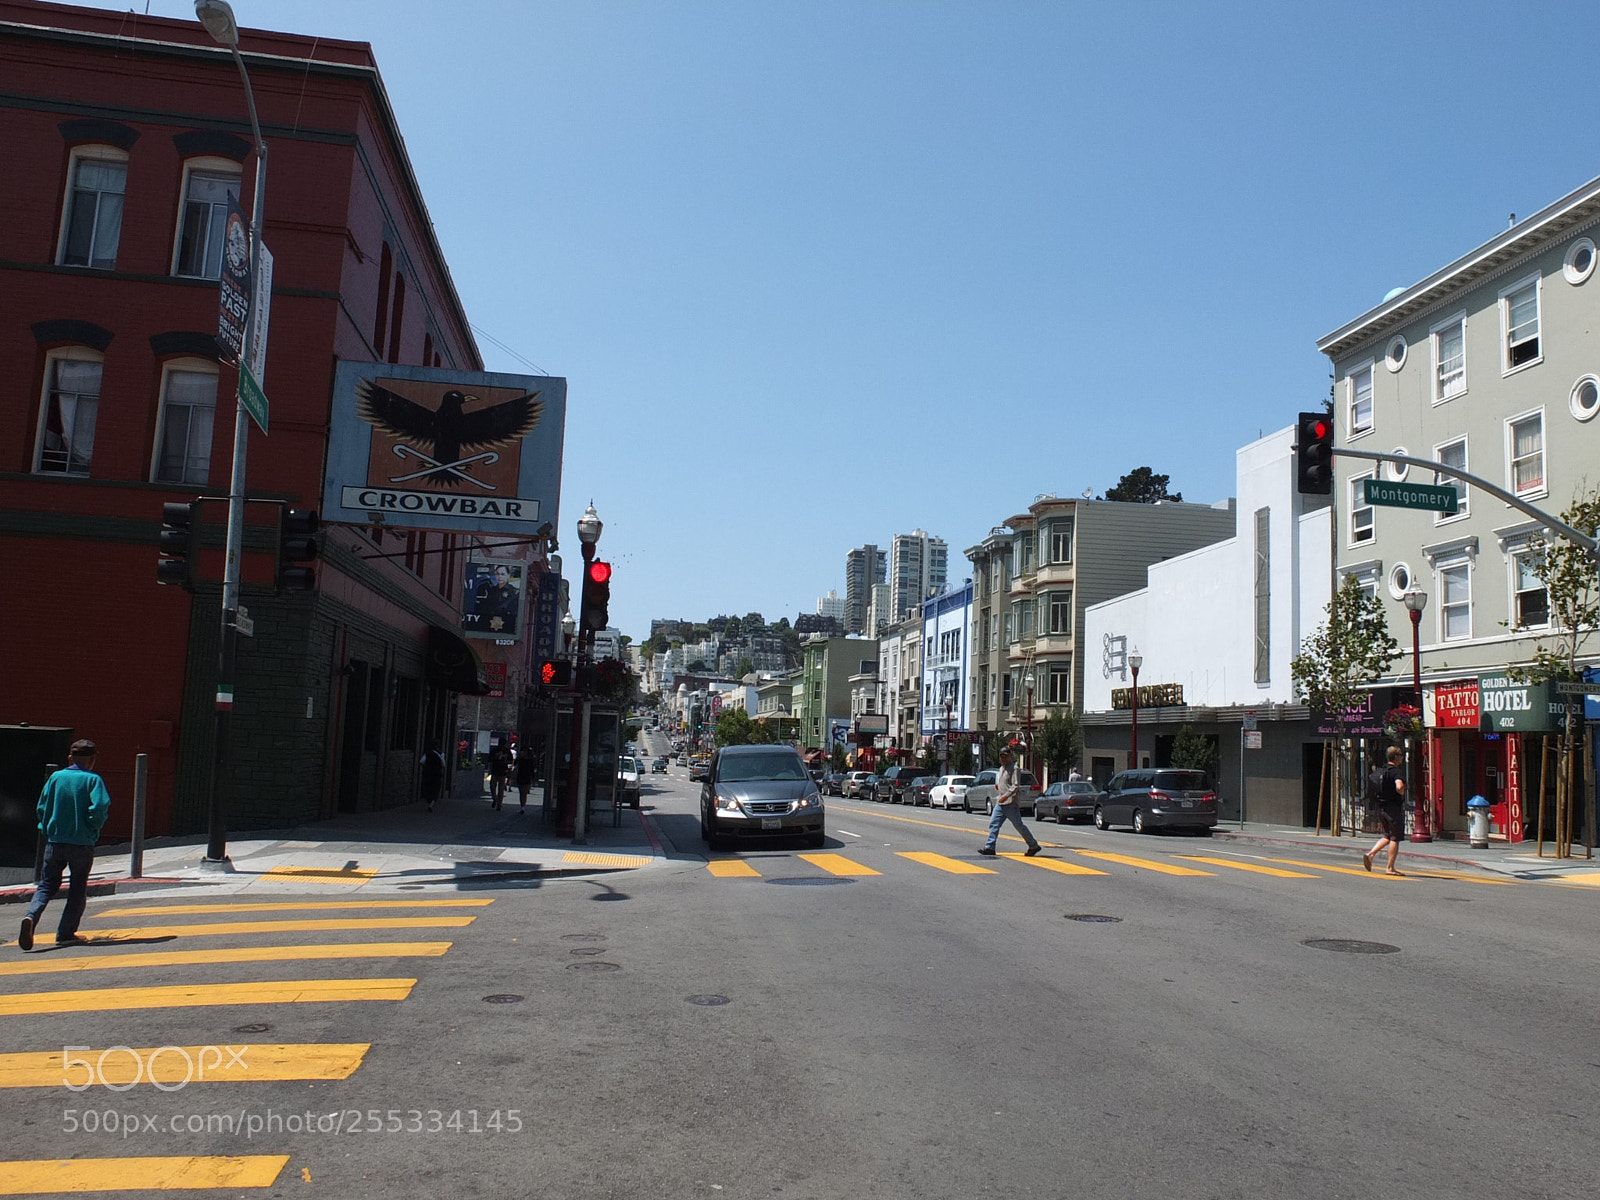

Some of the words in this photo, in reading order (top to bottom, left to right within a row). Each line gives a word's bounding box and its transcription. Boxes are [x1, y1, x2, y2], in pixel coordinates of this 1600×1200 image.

[222, 279, 249, 310] GOLDEN
[220, 292, 247, 323] PAST
[218, 325, 241, 353] FUTURE
[219, 315, 243, 341] BRIGHT
[243, 375, 265, 424] Broadway
[358, 490, 522, 517] CROWBAR
[1371, 485, 1450, 507] Montgomery
[1482, 677, 1508, 688] GOLDEN
[1324, 693, 1374, 713] SNSET
[1483, 690, 1532, 712] HOTEL
[1450, 709, 1476, 717] PARLOR
[1457, 717, 1471, 725] 404
[1499, 717, 1515, 727] 402
[1557, 717, 1578, 728] 42
[1509, 738, 1520, 835] TATTOO
